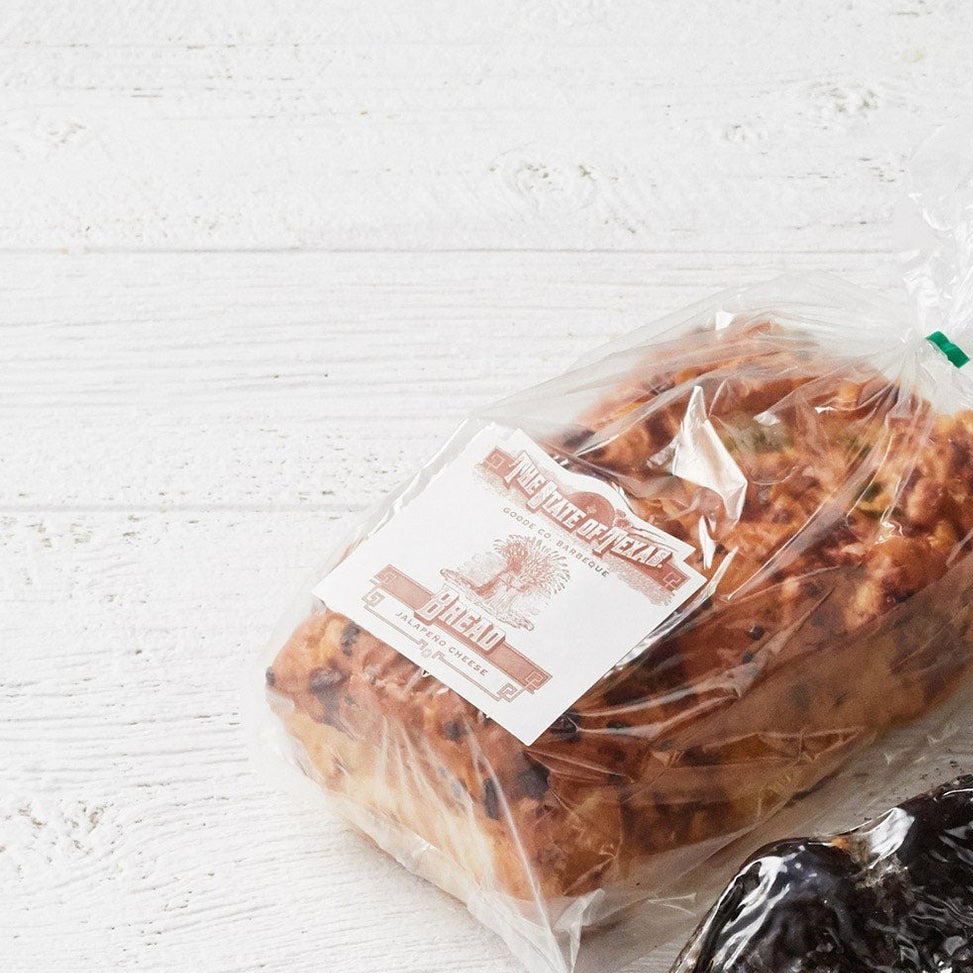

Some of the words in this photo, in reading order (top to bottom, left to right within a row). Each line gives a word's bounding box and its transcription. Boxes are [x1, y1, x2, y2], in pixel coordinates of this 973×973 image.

[504, 451, 546, 495] THE
[527, 480, 586, 529] STATE
[578, 518, 609, 541] OF
[503, 507, 536, 530] GOODE
[556, 540, 609, 578] BARBEQUE
[395, 612, 446, 647] JALAPEÑO
[449, 646, 488, 677] CHEESE
[415, 583, 506, 651] BREAD
